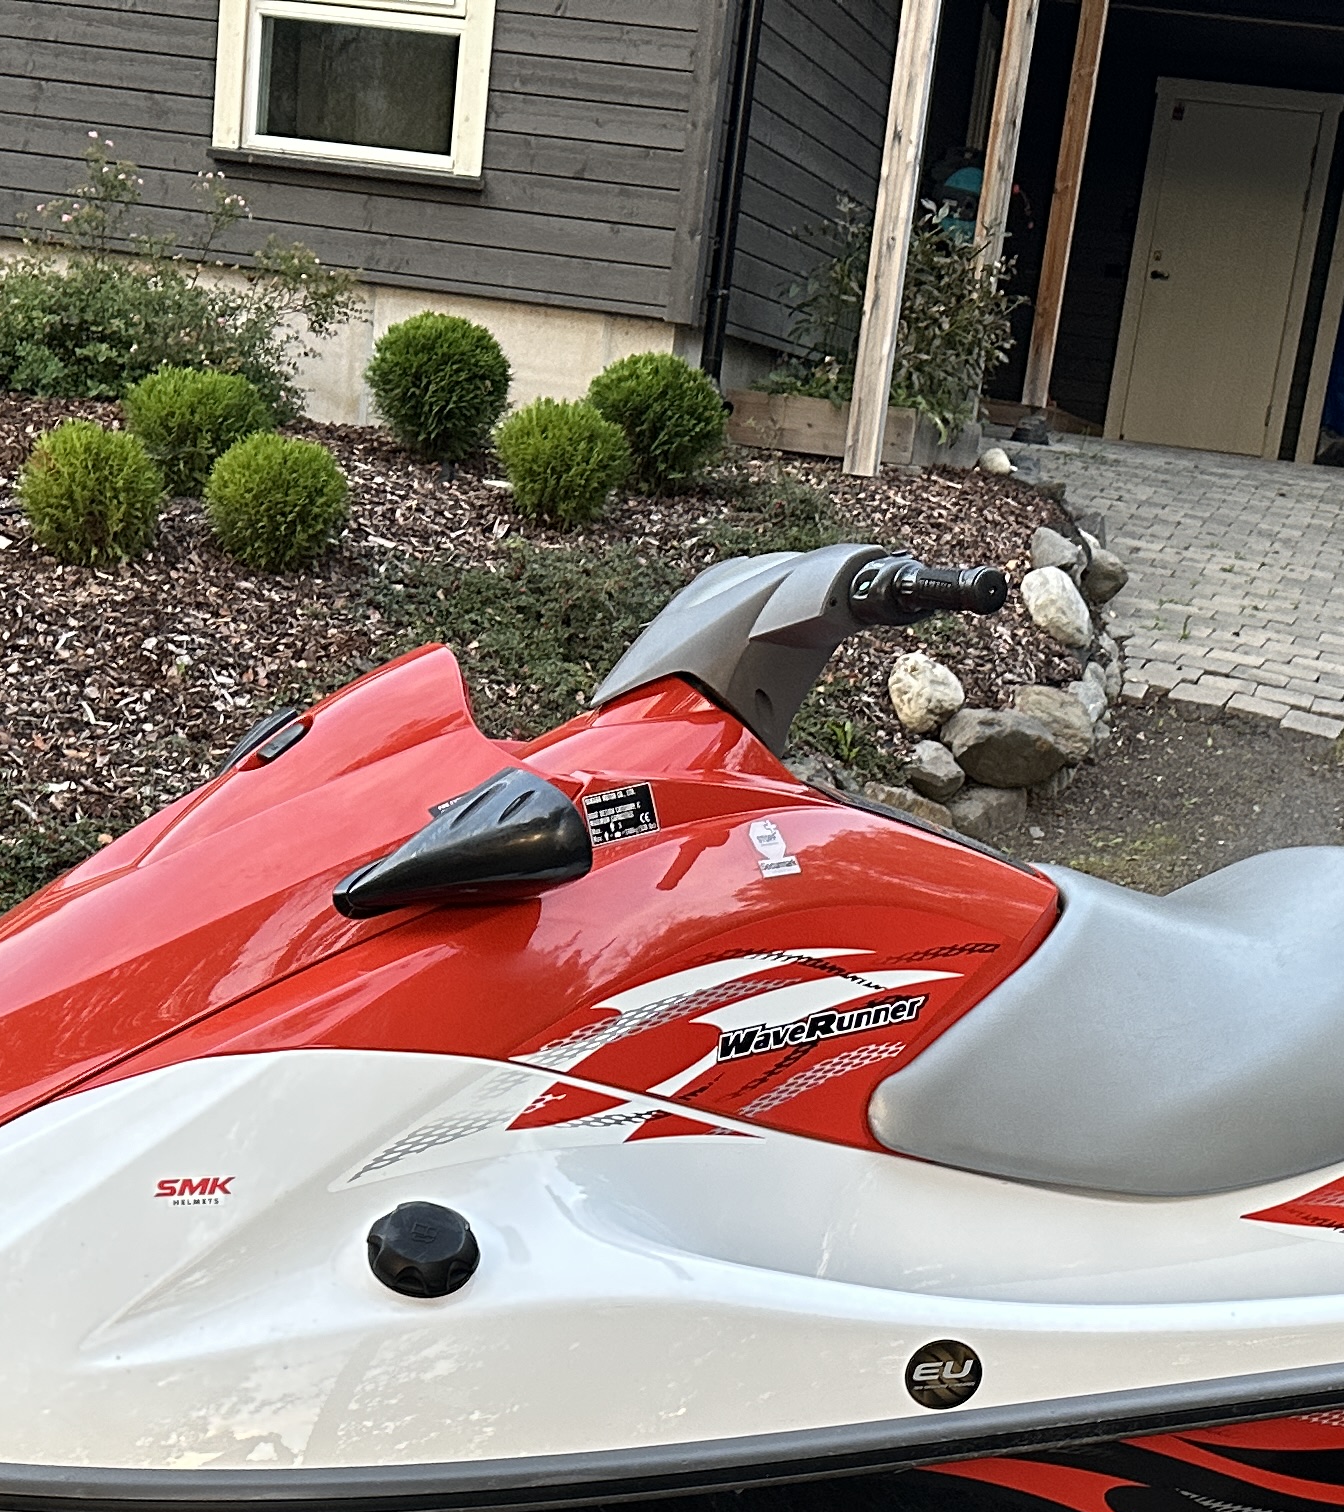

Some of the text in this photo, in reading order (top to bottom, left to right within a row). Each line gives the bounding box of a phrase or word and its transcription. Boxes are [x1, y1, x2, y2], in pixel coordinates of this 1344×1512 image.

[717, 995, 926, 1062] WaveRunner
[154, 1176, 236, 1198] SMK
[172, 1198, 219, 1206] HELMETS
[912, 1359, 974, 1382] EU
